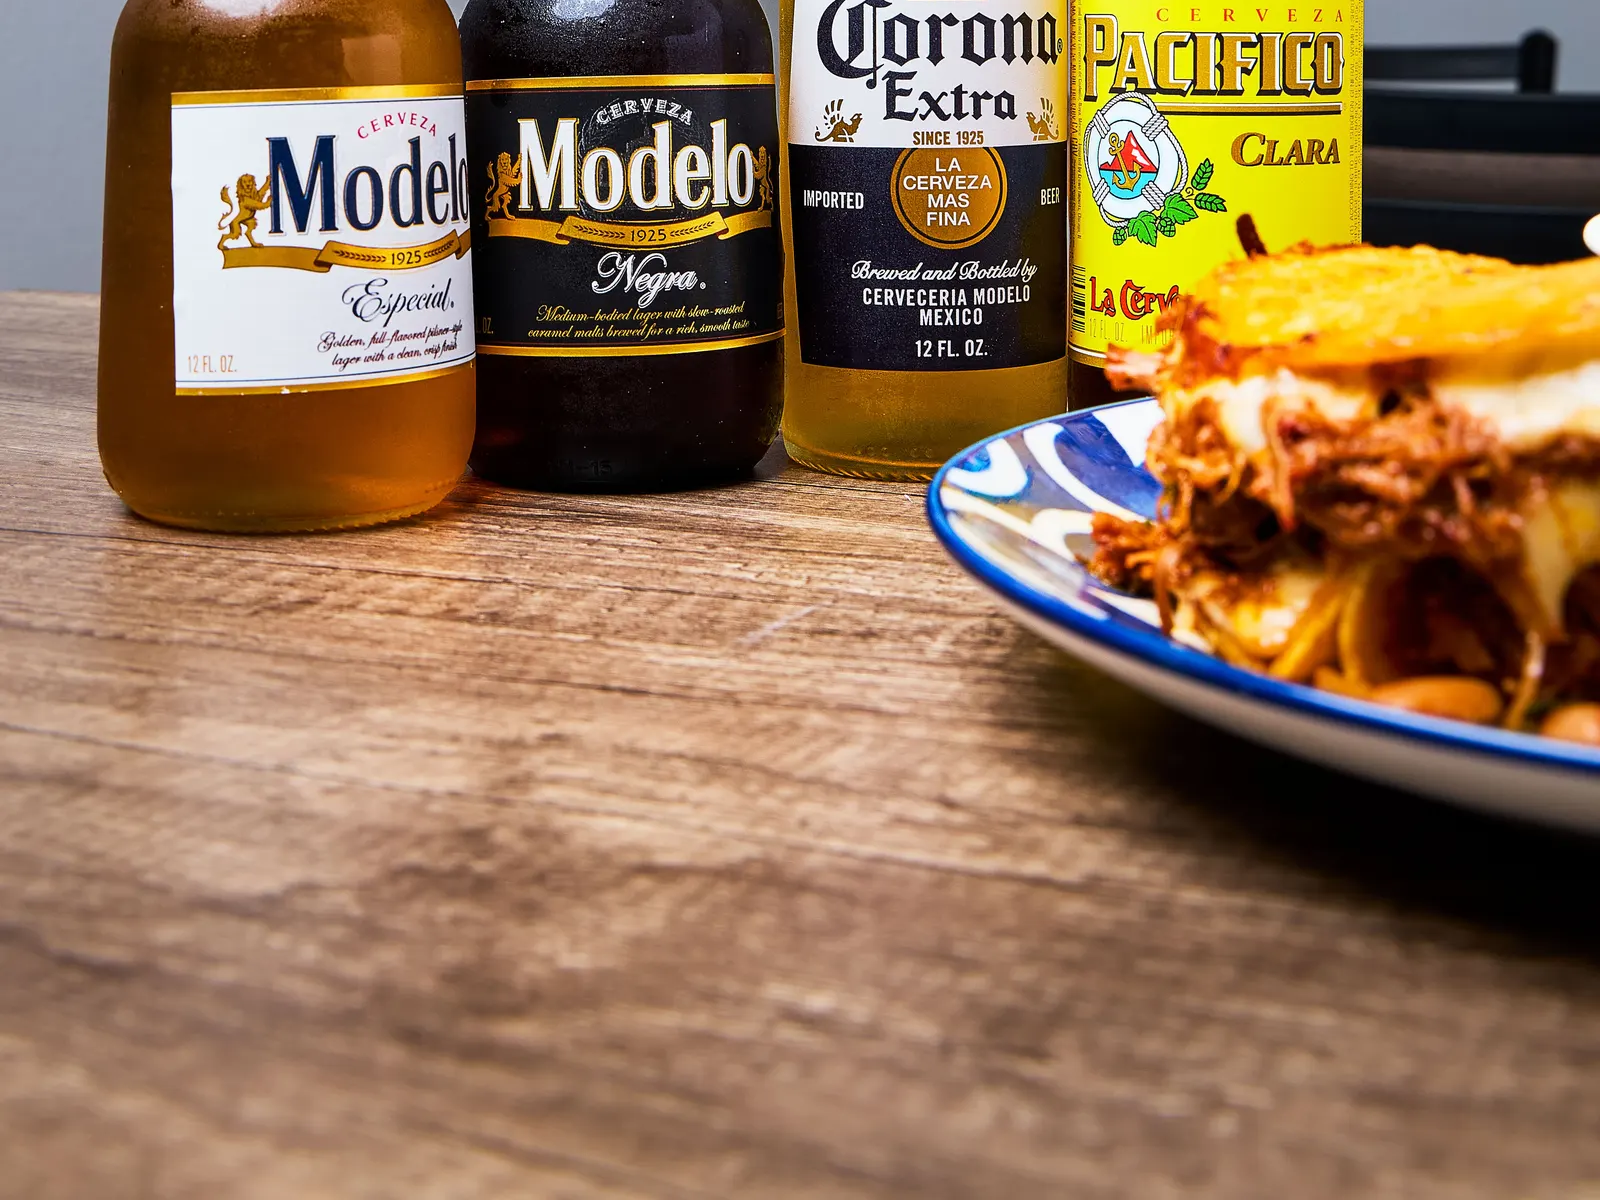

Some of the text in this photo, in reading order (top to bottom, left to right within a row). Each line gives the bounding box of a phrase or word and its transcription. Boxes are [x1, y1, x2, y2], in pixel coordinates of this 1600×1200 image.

[1156, 8, 1343, 23] CERVEZA
[1083, 13, 1345, 103] PACIFICO
[882, 70, 1018, 122] Extra
[596, 98, 693, 126] CERVEZA
[358, 111, 437, 139] CERVEZA
[912, 130, 984, 146] SINCE 1925
[517, 117, 756, 213] Modelo
[934, 157, 962, 173] LA
[266, 132, 470, 234] Modelo
[902, 175, 993, 191] CERVEZA
[803, 186, 1061, 210] IMPORTED BEER
[927, 193, 970, 209] MAS
[926, 211, 971, 227] FINA
[629, 228, 668, 243] 1925
[390, 251, 422, 266] 1925
[851, 257, 1038, 283] Brewed and Bottled by
[862, 284, 1031, 307] CERVECERIA MODELO
[1089, 276, 1116, 318] La
[536, 300, 746, 327] Medium-bodied lager with slow-roasted
[919, 307, 983, 326] MEXICO
[317, 331, 366, 353] Golden,
[364, 326, 429, 351] full-flavored
[527, 324, 574, 338] caramel
[574, 324, 605, 338] malts
[606, 324, 648, 338] brewed
[641, 322, 665, 341] for
[665, 327, 675, 335] a
[676, 320, 698, 335] rich,
[699, 318, 732, 333] smooth
[1114, 321, 1128, 343] OZ.
[332, 339, 458, 372] lager with a clean, crisp finish
[915, 338, 989, 358] 12 FL. OZ.
[187, 354, 238, 374] 12 FL. OZ.
